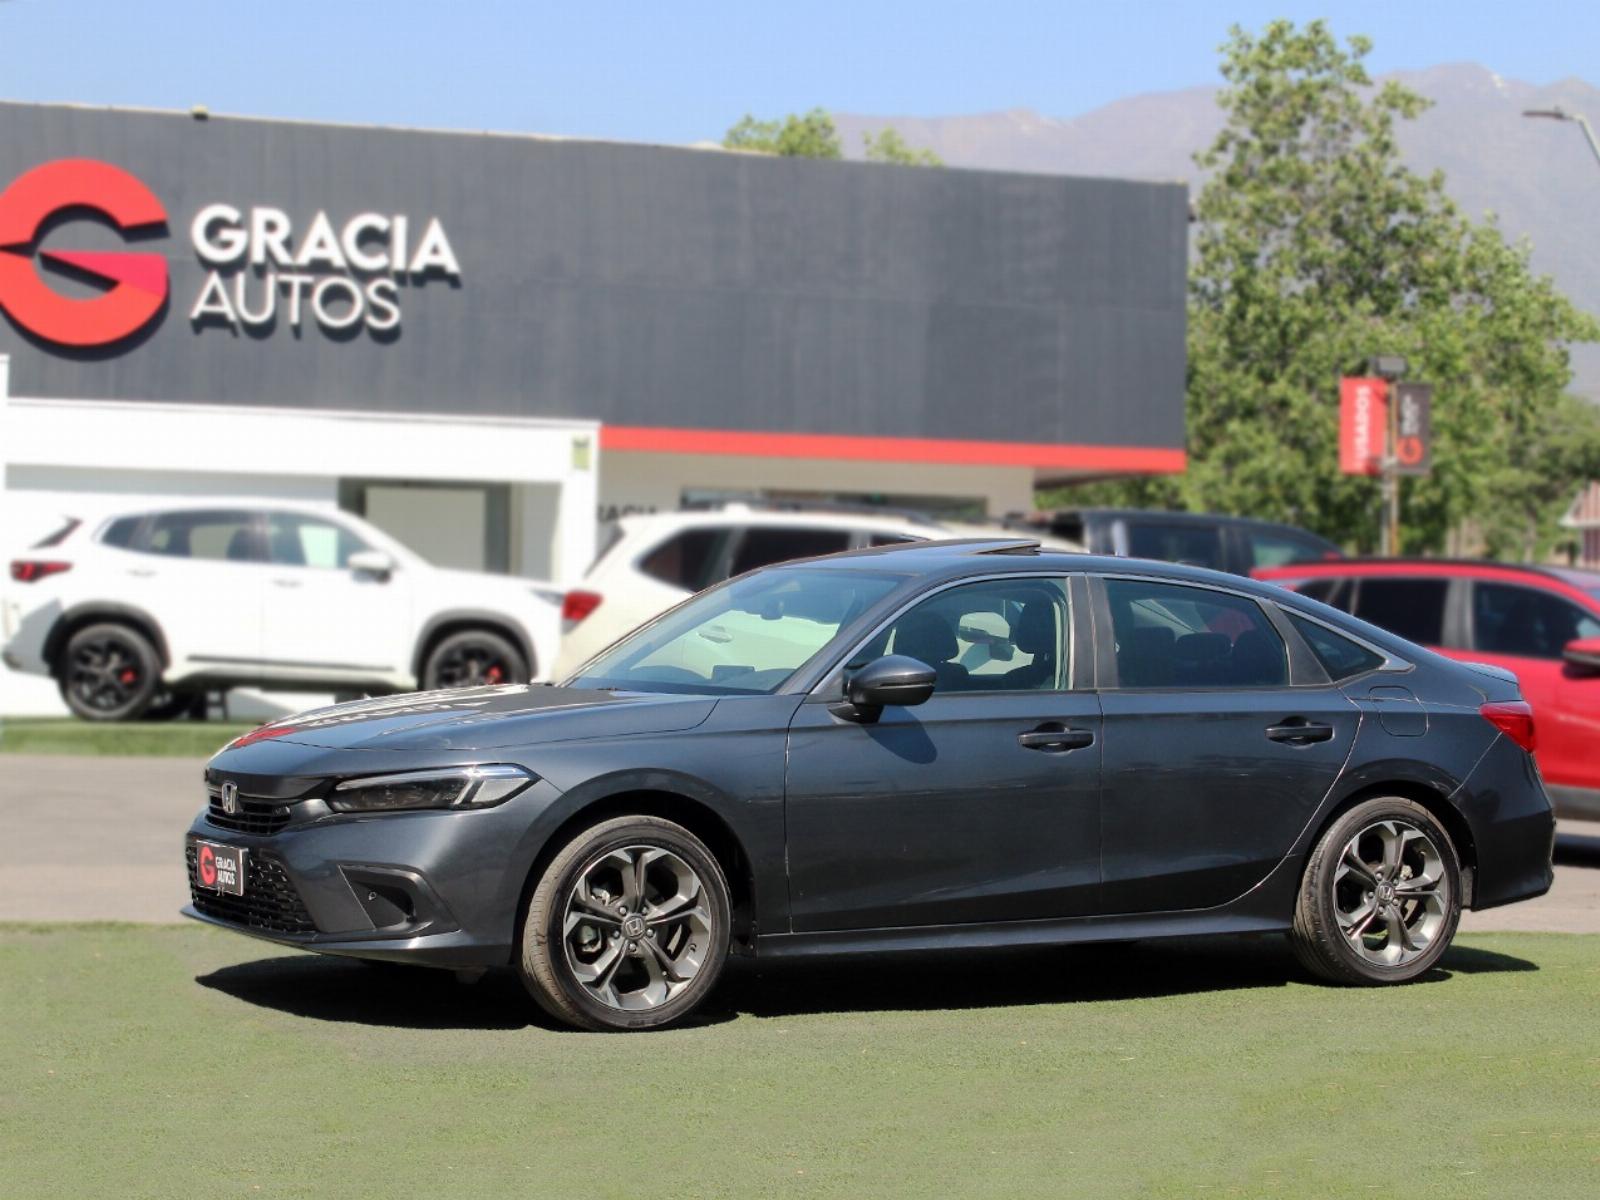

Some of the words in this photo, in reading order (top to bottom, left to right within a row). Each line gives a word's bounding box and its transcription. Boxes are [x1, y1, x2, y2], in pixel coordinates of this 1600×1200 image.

[190, 203, 461, 275] GRACIA
[189, 271, 402, 331] AUTOS
[217, 869, 235, 885] AUTOS
